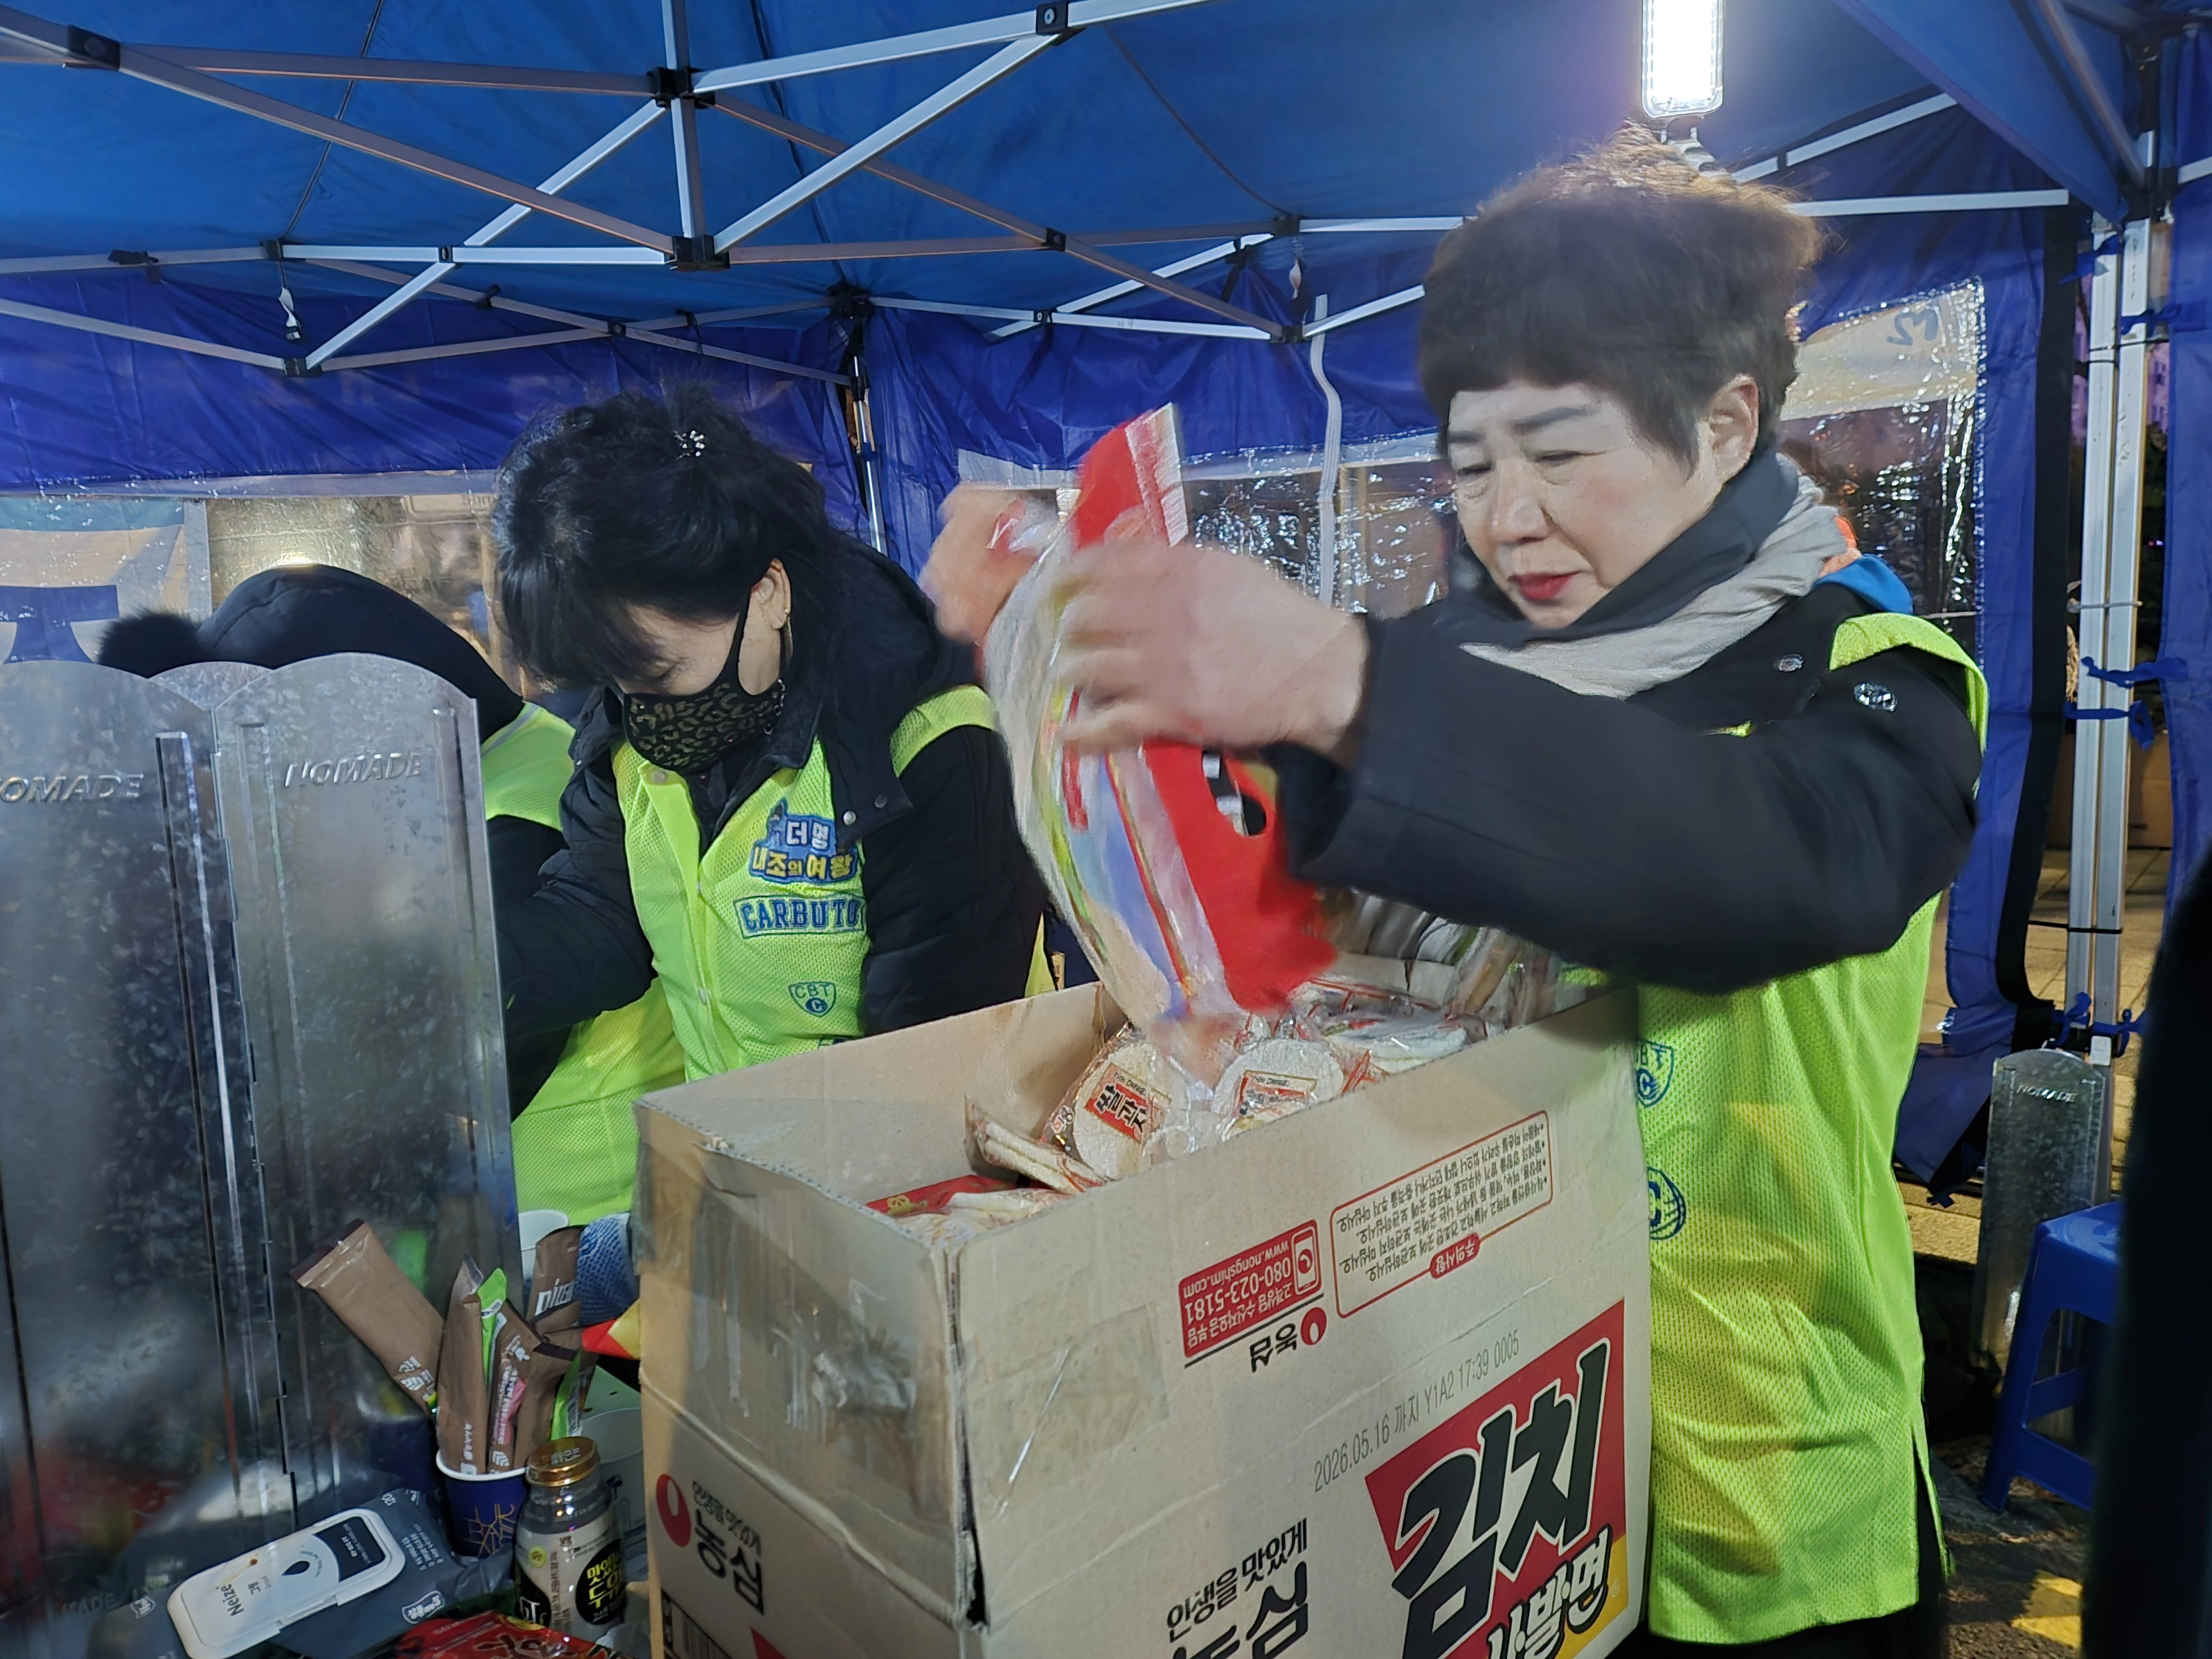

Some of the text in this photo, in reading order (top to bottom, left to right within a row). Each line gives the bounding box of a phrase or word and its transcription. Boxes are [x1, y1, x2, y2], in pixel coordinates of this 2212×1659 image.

[0, 773, 144, 803] OMADE
[794, 983, 830, 999] CBT
[1337, 1207, 1370, 1232] 마십시오.
[1373, 1196, 1387, 1217] 주지
[1357, 1208, 1407, 1244] 보관하십시오.
[1379, 1227, 1410, 1256] 보관하지
[1183, 1239, 1290, 1299] www.nongshim.com
[1339, 1246, 1376, 1273] 마십시오.
[1366, 1245, 1416, 1281] 보관하십시오.
[1435, 1239, 1477, 1274] 주의사항
[1185, 1257, 1292, 1324] 080-023-5181
[1259, 1283, 1291, 1312] 고객상담
[1249, 1323, 1298, 1373] 농심
[1314, 1328, 1520, 1493] 2026.05.16 까지 Y1A2 17:39 0005
[1391, 1338, 1610, 1659] 김치
[695, 1508, 764, 1616] 농심
[1166, 1517, 1307, 1644] 인생을 맛있게
[221, 1583, 245, 1616] Neize
